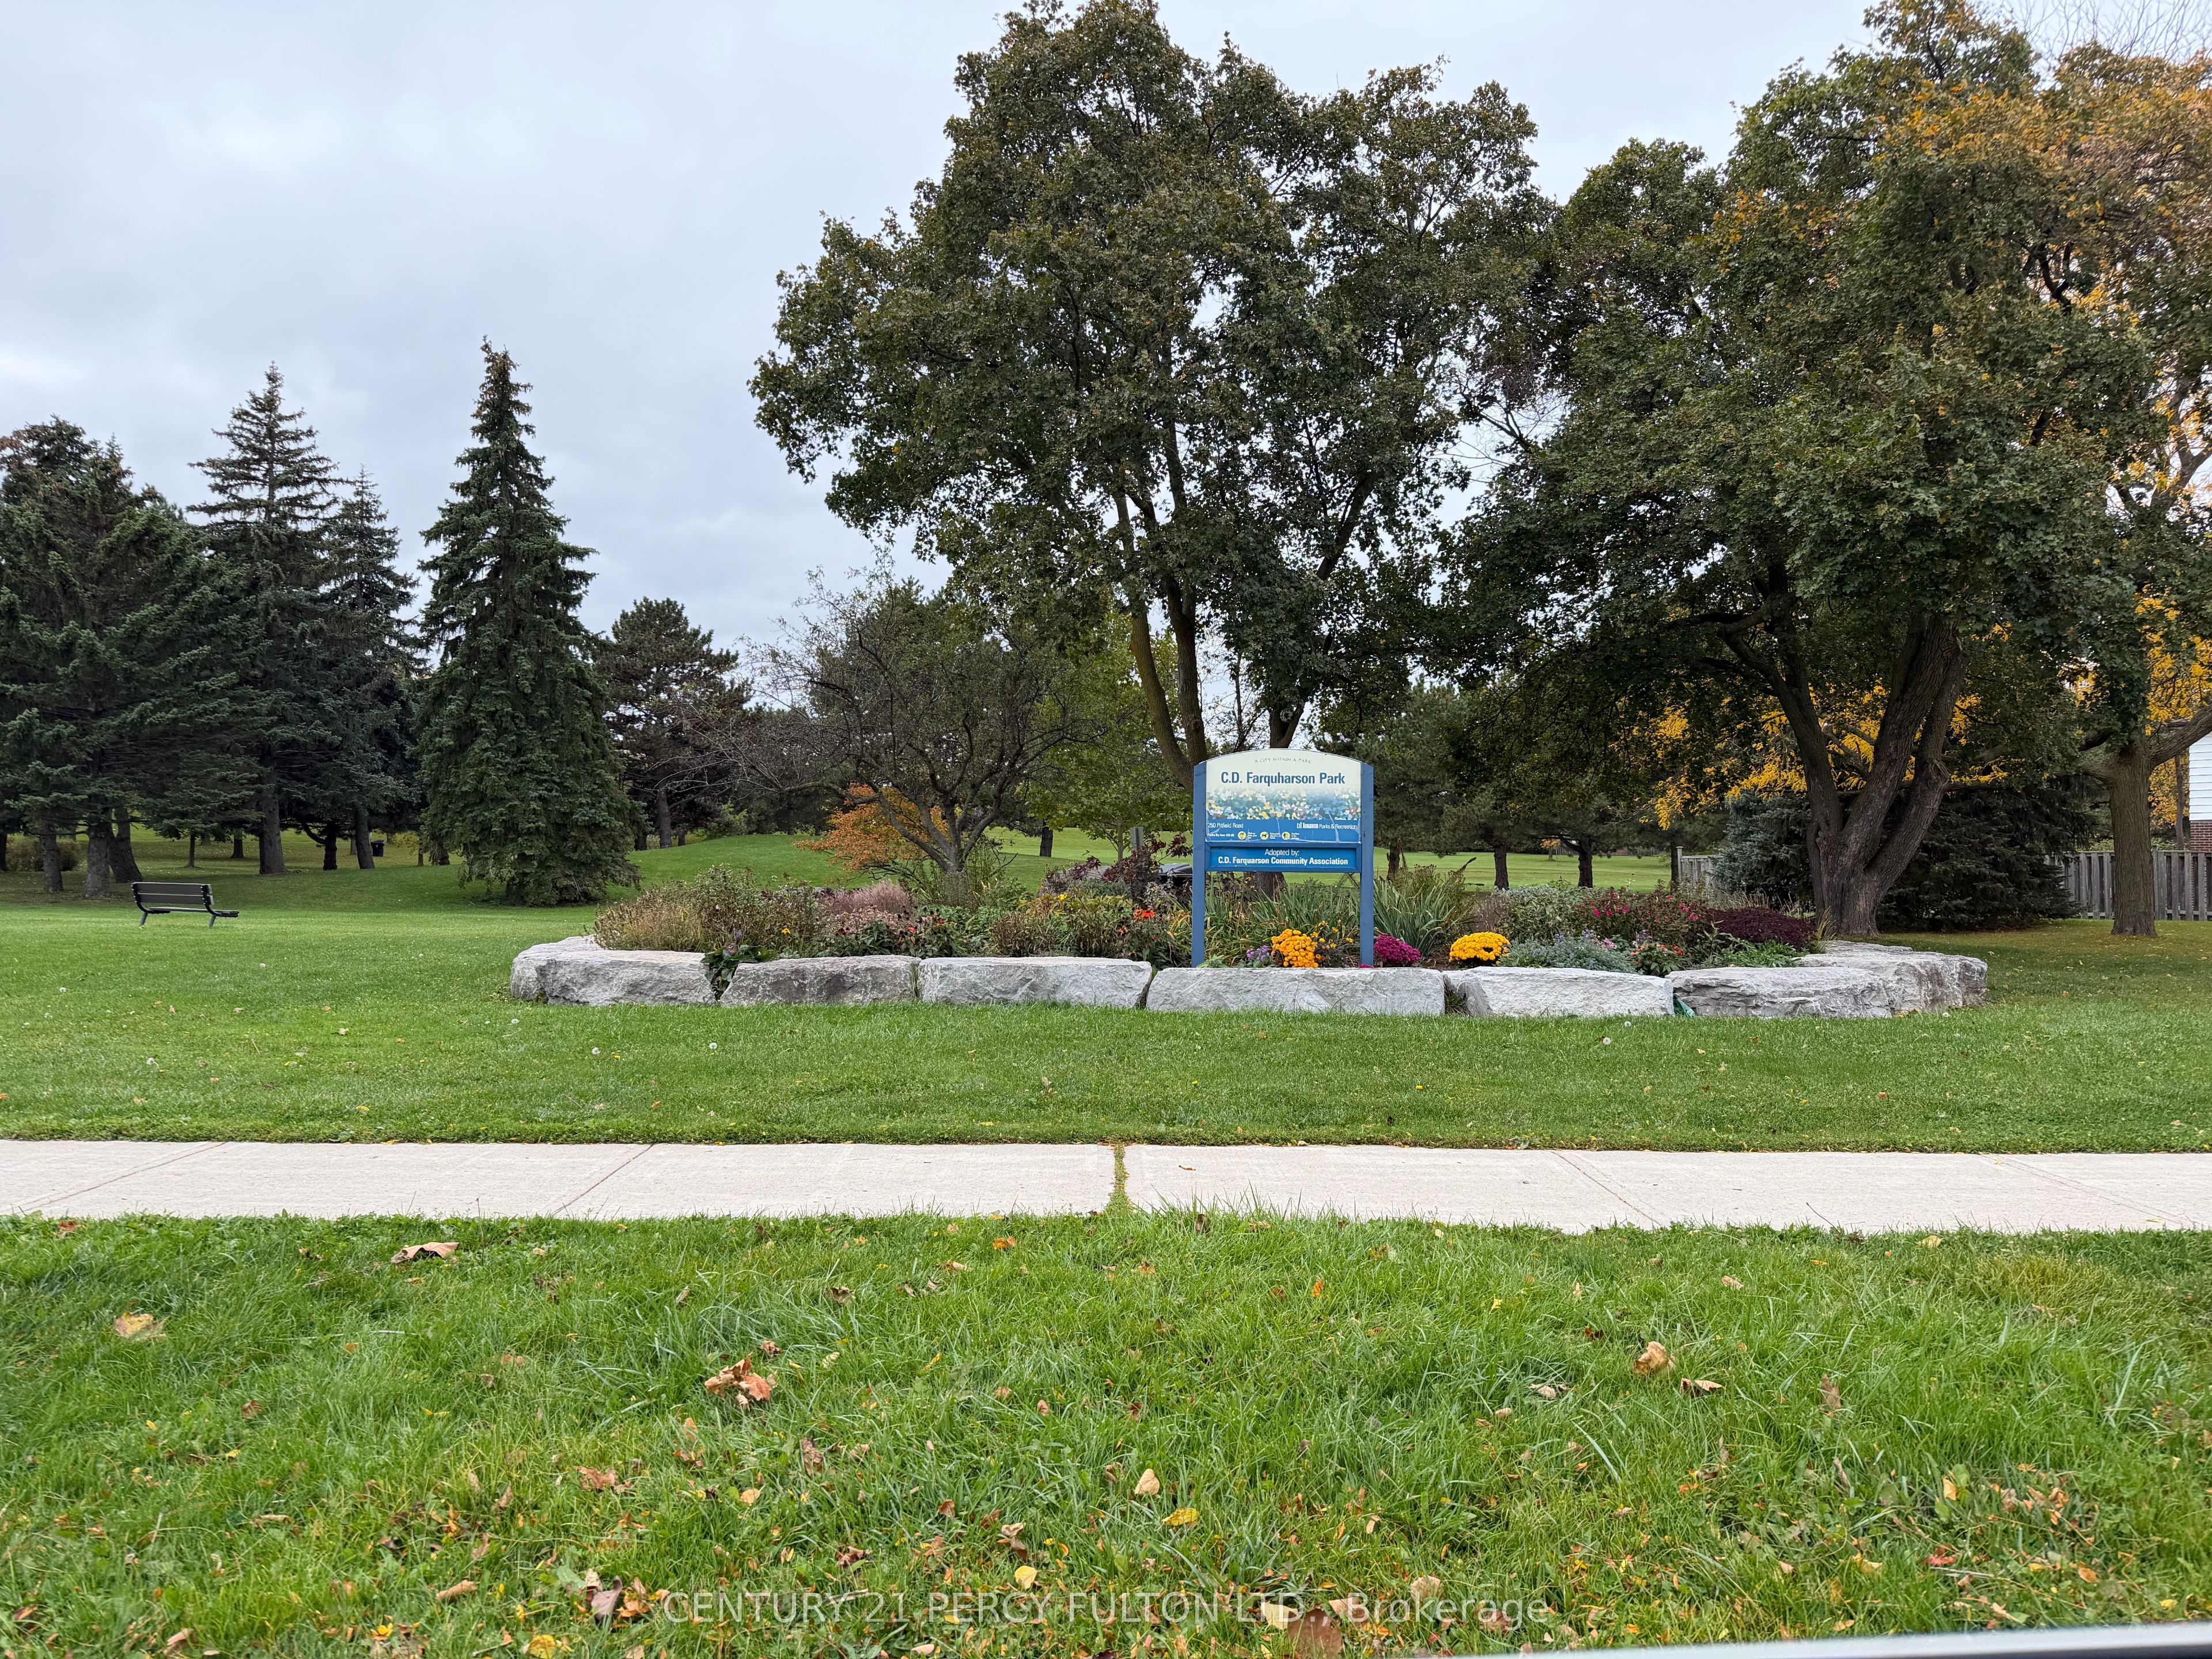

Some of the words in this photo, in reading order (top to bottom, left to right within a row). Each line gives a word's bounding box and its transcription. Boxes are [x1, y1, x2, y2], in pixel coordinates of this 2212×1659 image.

[1221, 772, 1242, 783] C.D.
[1247, 772, 1315, 786] Farquharson
[1319, 772, 1345, 783] Park
[1264, 849, 1290, 857] Adopted
[1291, 849, 1300, 857] by:
[1271, 857, 1308, 865] Community
